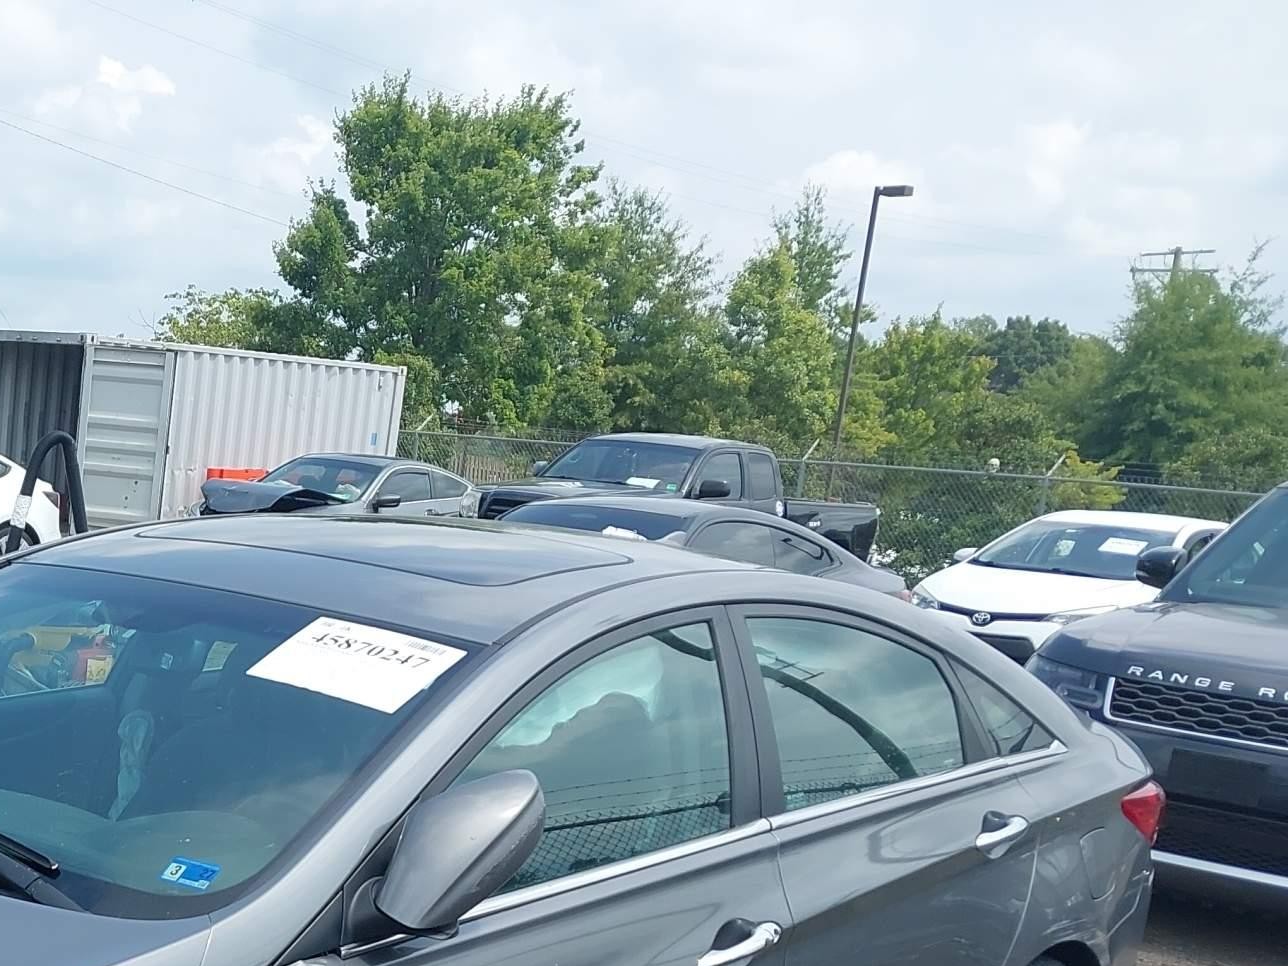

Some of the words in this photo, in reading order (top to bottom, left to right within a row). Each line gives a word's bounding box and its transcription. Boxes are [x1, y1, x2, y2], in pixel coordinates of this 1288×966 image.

[312, 632, 431, 669] 45870247
[1127, 665, 1236, 692] RANGE
[1258, 687, 1288, 702] R
[169, 865, 182, 876] 3
